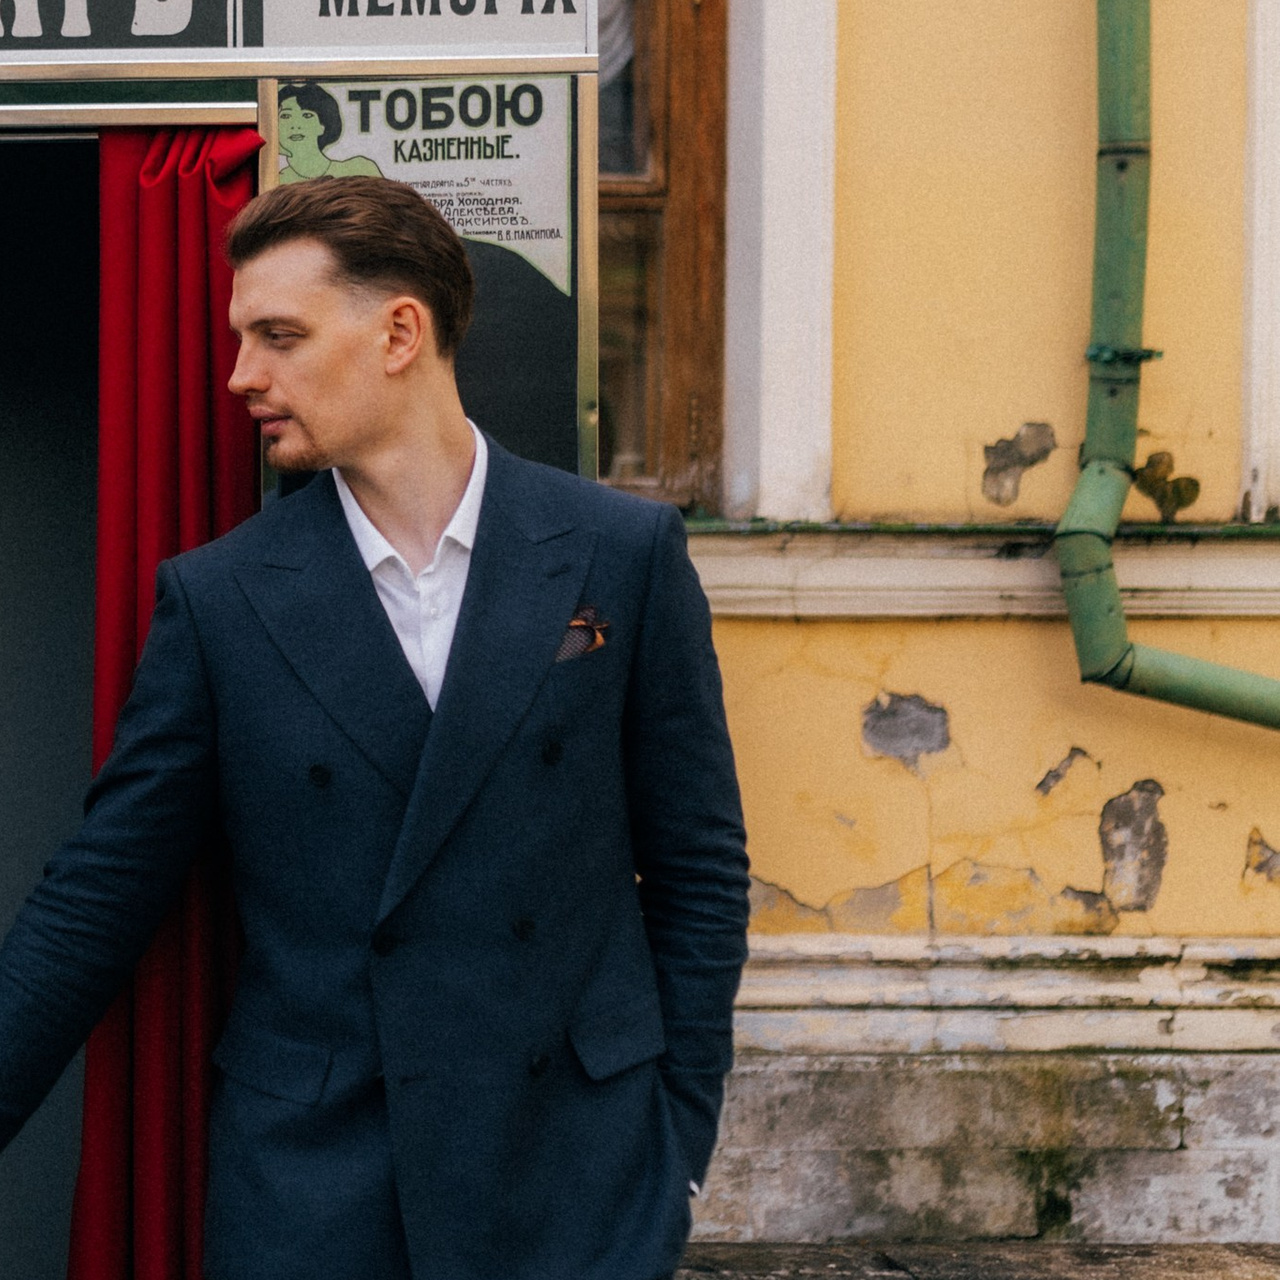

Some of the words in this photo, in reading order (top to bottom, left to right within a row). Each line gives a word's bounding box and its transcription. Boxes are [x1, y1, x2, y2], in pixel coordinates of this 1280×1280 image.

[348, 83, 543, 134] ТОБОЮ
[393, 134, 521, 163] КАЗНЕННЫЕ.
[458, 196, 523, 207] ХОЛОДНАЯ.
